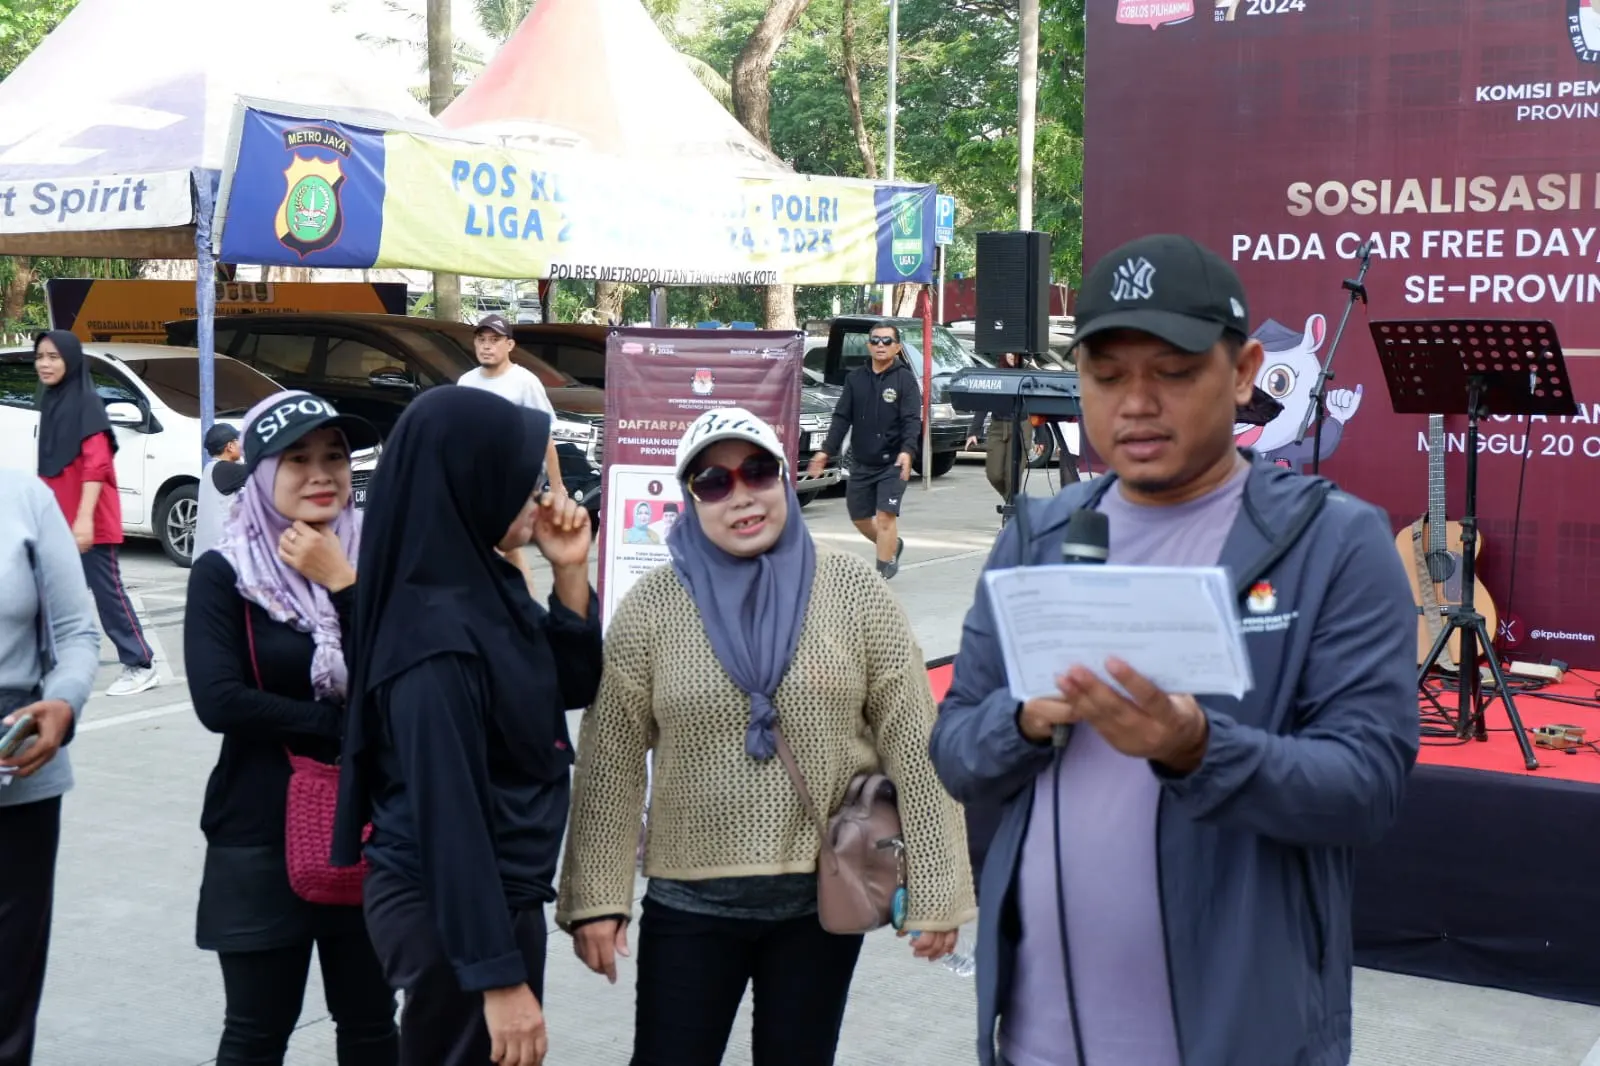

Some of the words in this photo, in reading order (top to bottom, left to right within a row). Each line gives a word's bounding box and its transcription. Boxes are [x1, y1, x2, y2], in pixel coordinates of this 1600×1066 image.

[1246, 0, 1306, 15] 2024
[1476, 83, 1552, 101] KOMISI
[1517, 102, 1600, 121] PROVIN
[288, 132, 322, 145] METRO
[323, 134, 347, 152] JAYA
[452, 160, 517, 198] POS
[30, 178, 147, 222] Spirit
[1286, 173, 1581, 217] SOSIALISASI
[772, 193, 838, 223] POLRI
[465, 203, 544, 242] LIGA
[778, 228, 834, 254] 2025
[1232, 232, 1325, 262] PADA
[1335, 229, 1411, 261] CAR
[1422, 228, 1504, 259] FREE
[550, 263, 597, 281] POLRES
[600, 265, 688, 284] METROPOLITAN
[690, 268, 751, 285] TANGERANG
[753, 270, 777, 285] KOTA
[969, 378, 1002, 390] YAMAHA
[619, 419, 667, 431] DAFTAR
[618, 437, 660, 446] PEMILIHAN
[1541, 433, 1574, 456] 20
[652, 482, 659, 493] 1
[1531, 629, 1595, 642] @kpubanten
